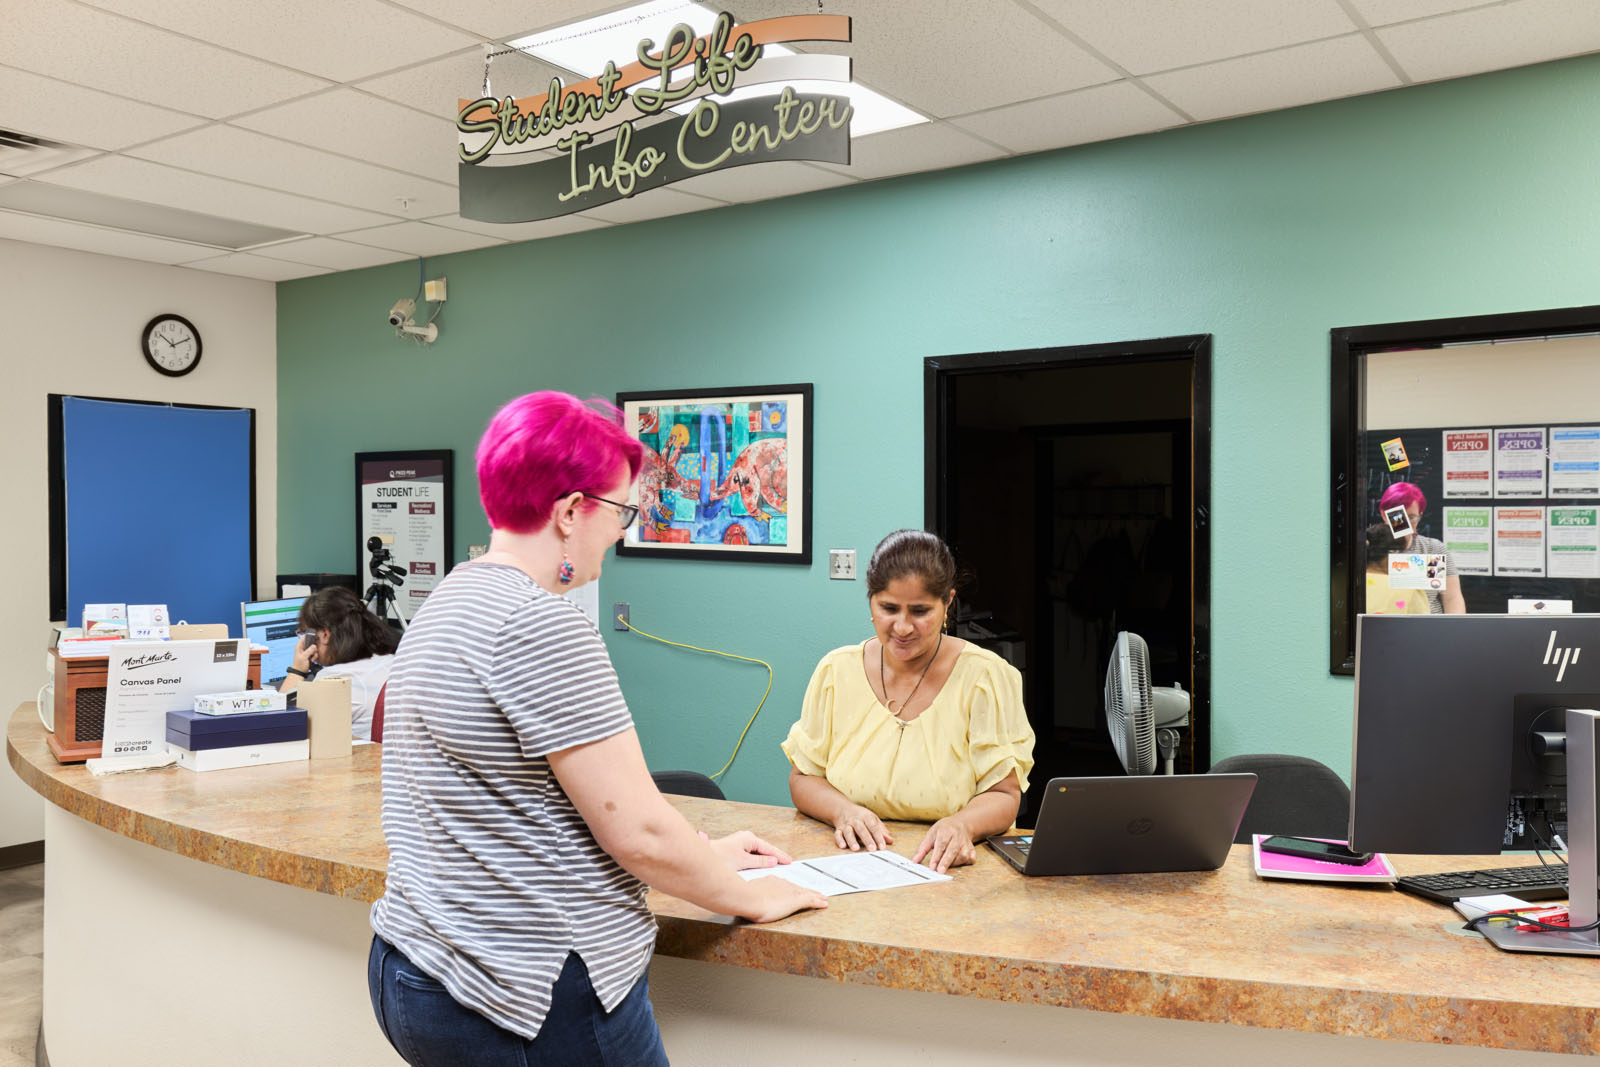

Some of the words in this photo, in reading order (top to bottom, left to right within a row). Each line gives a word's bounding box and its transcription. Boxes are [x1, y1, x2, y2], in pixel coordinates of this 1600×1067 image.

[456, 60, 624, 162] Student
[632, 12, 763, 113] Life
[558, 121, 667, 202] Info
[676, 87, 852, 171] Center
[376, 487, 413, 497] STUDENT
[414, 487, 430, 496] LIFE
[121, 656, 145, 668] Mont
[1542, 630, 1581, 682] hp
[156, 677, 182, 685] Panel
[232, 699, 254, 709] WTF
